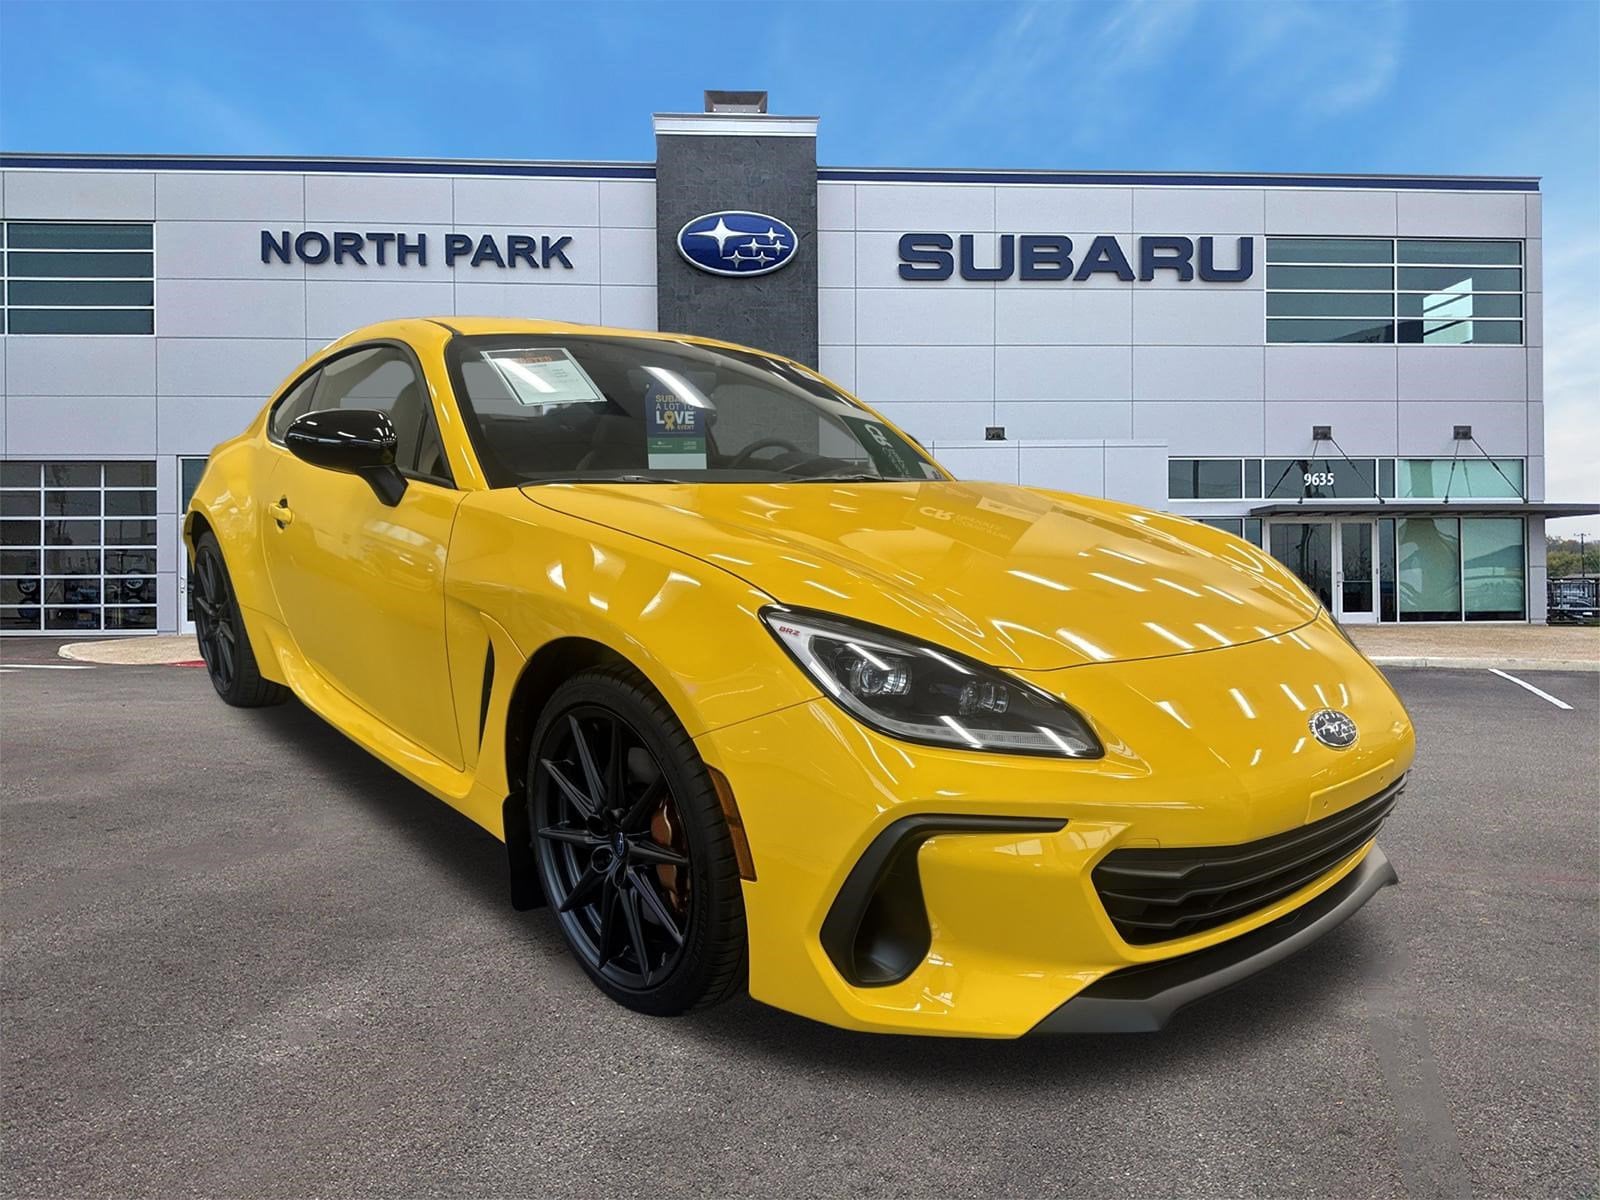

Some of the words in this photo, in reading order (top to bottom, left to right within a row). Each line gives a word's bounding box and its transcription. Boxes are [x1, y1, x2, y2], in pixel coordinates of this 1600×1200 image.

[261, 230, 427, 266] NORTH
[444, 233, 574, 269] PARK
[898, 232, 1254, 282] SUBARU
[656, 410, 694, 424] LOVE
[1303, 472, 1335, 486] 9635
[778, 626, 800, 636] BRZ
